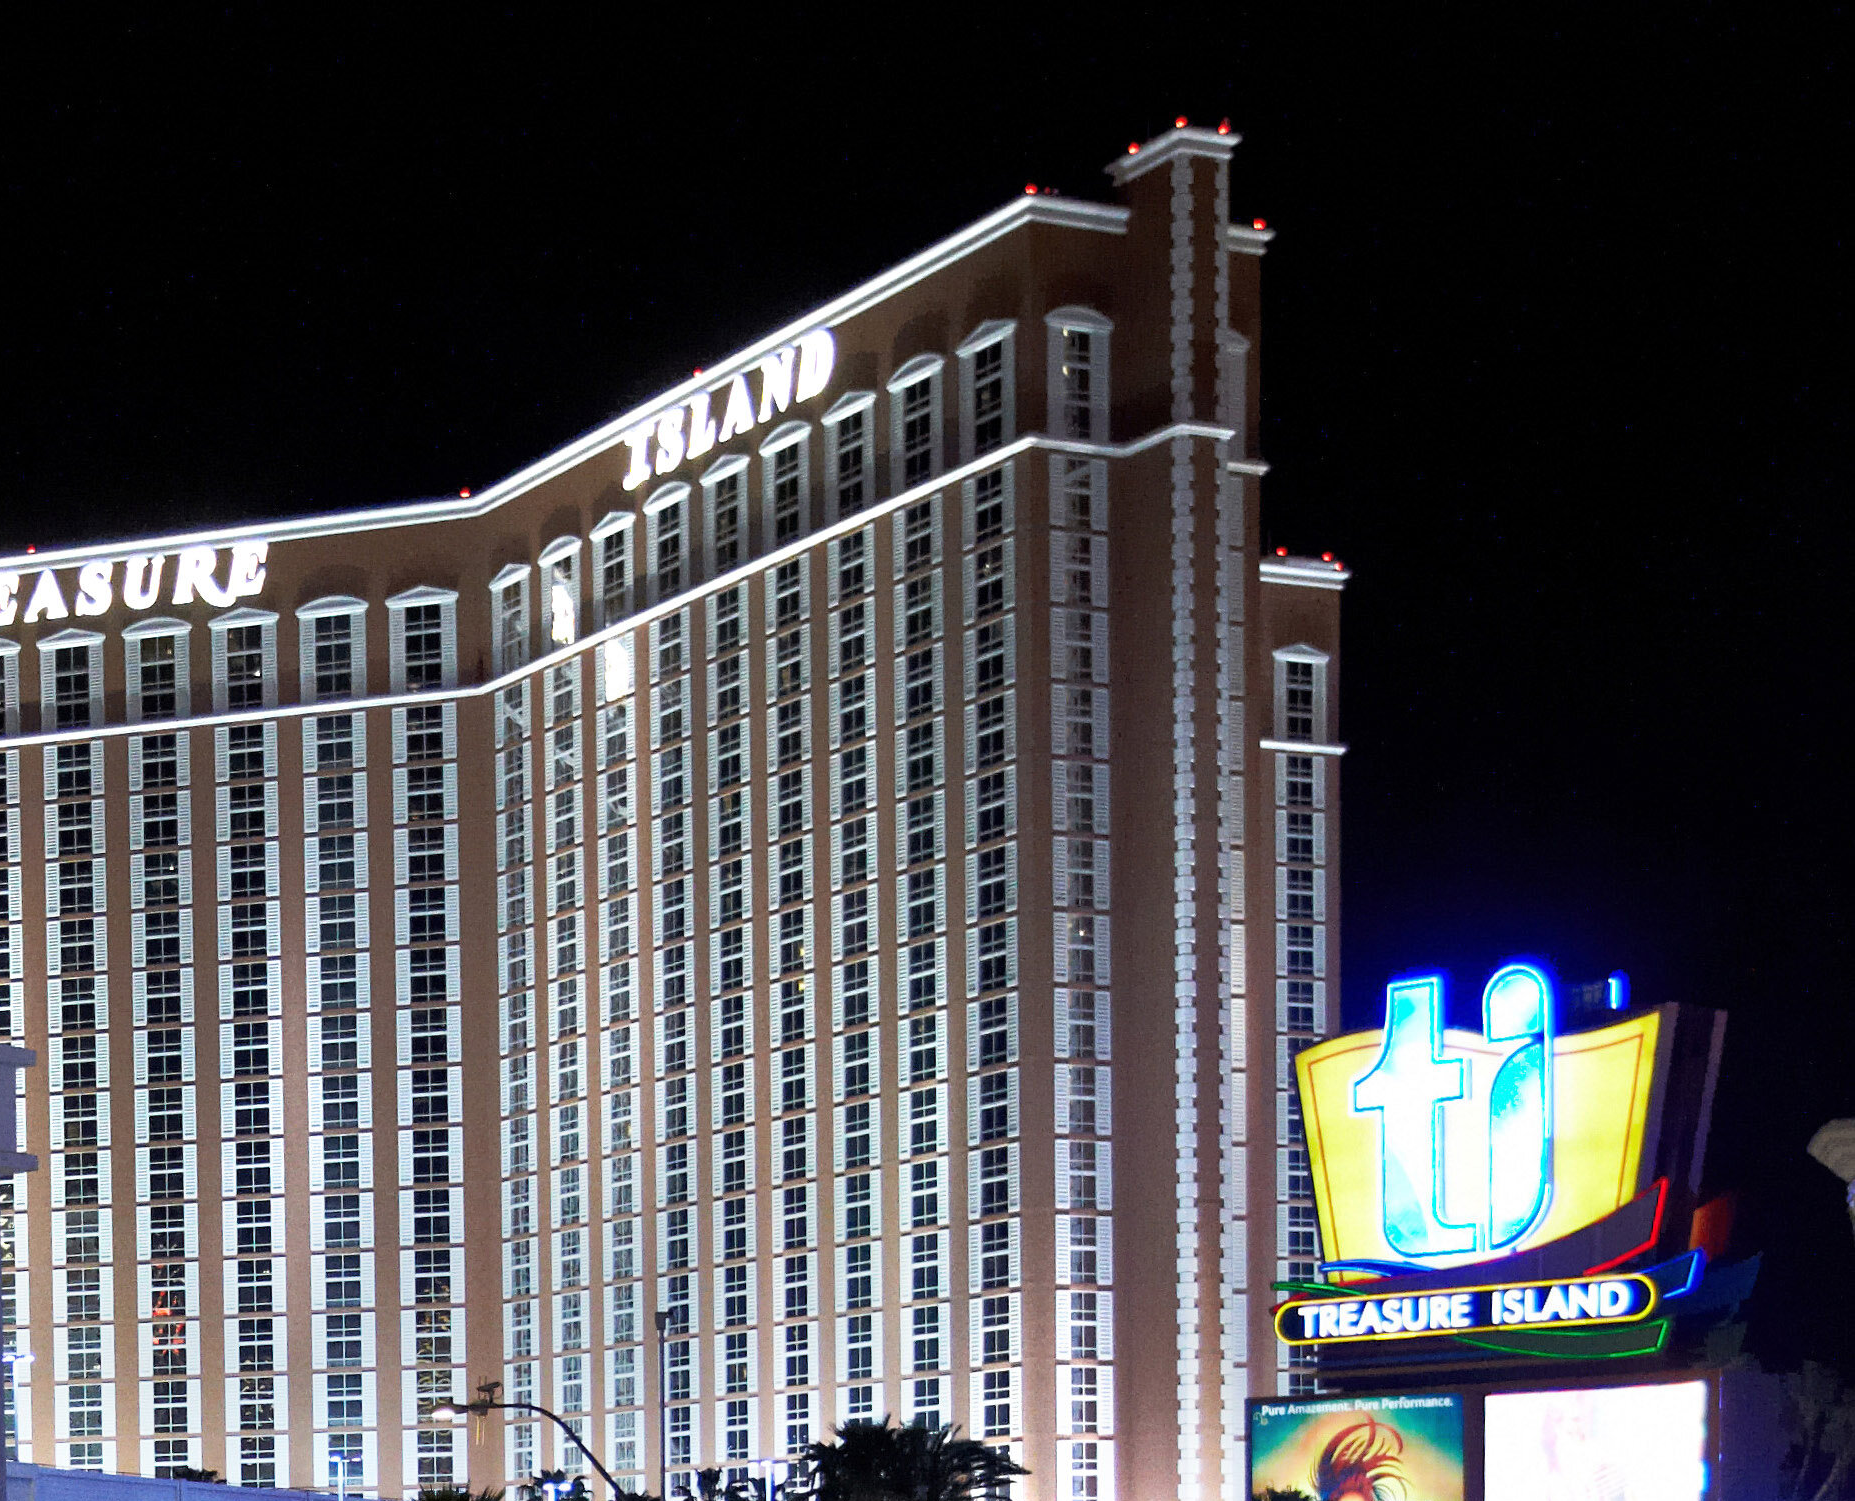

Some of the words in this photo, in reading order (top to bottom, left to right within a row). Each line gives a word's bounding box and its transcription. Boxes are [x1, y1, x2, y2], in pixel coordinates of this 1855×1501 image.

[622, 328, 837, 491] ISLAND
[1298, 1293, 1471, 1339] TREASURE
[1491, 1282, 1633, 1326] ISLAND
[1261, 1405, 1285, 1416] Pure
[1354, 1399, 1378, 1411] Pure
